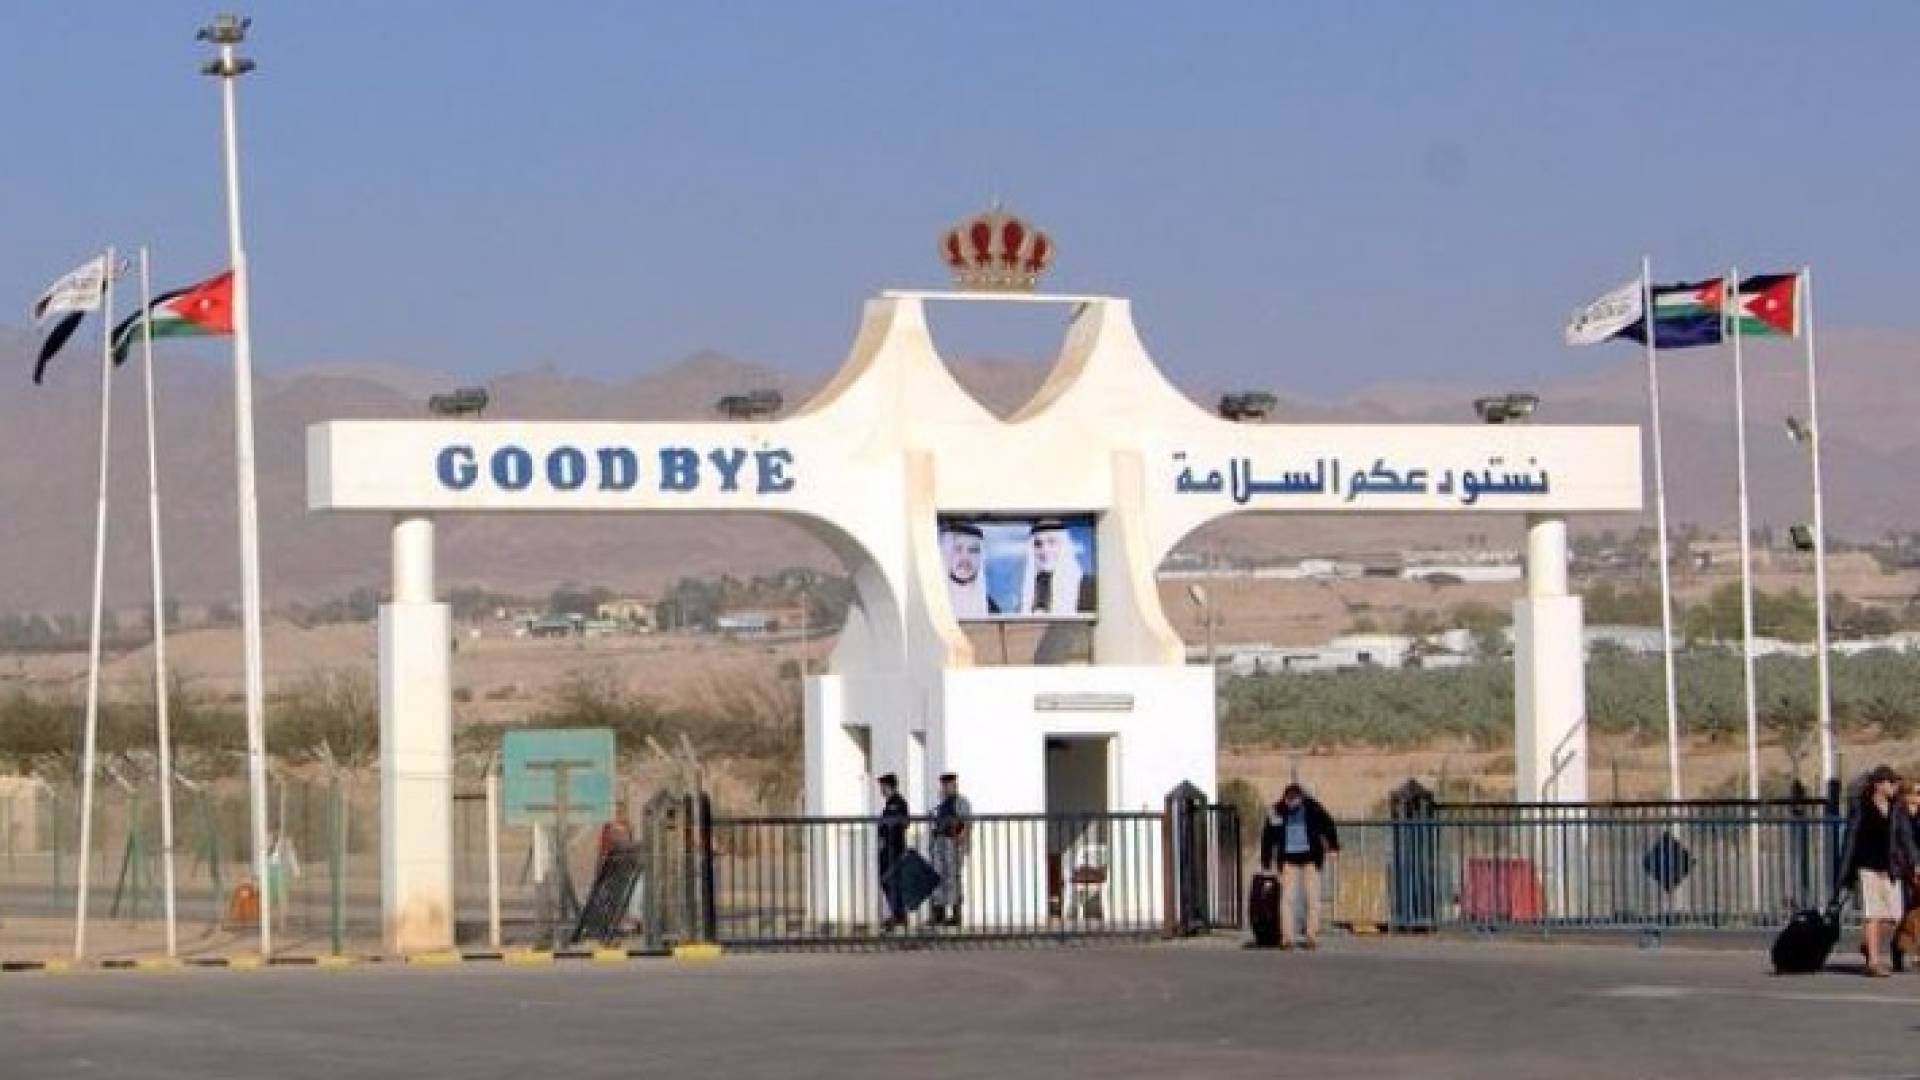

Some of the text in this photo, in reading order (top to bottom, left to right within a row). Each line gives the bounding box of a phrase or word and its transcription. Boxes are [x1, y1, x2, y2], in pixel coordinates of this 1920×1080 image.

[436, 443, 795, 494] GOOD BYE
[1172, 452, 1339, 504] السلامة
